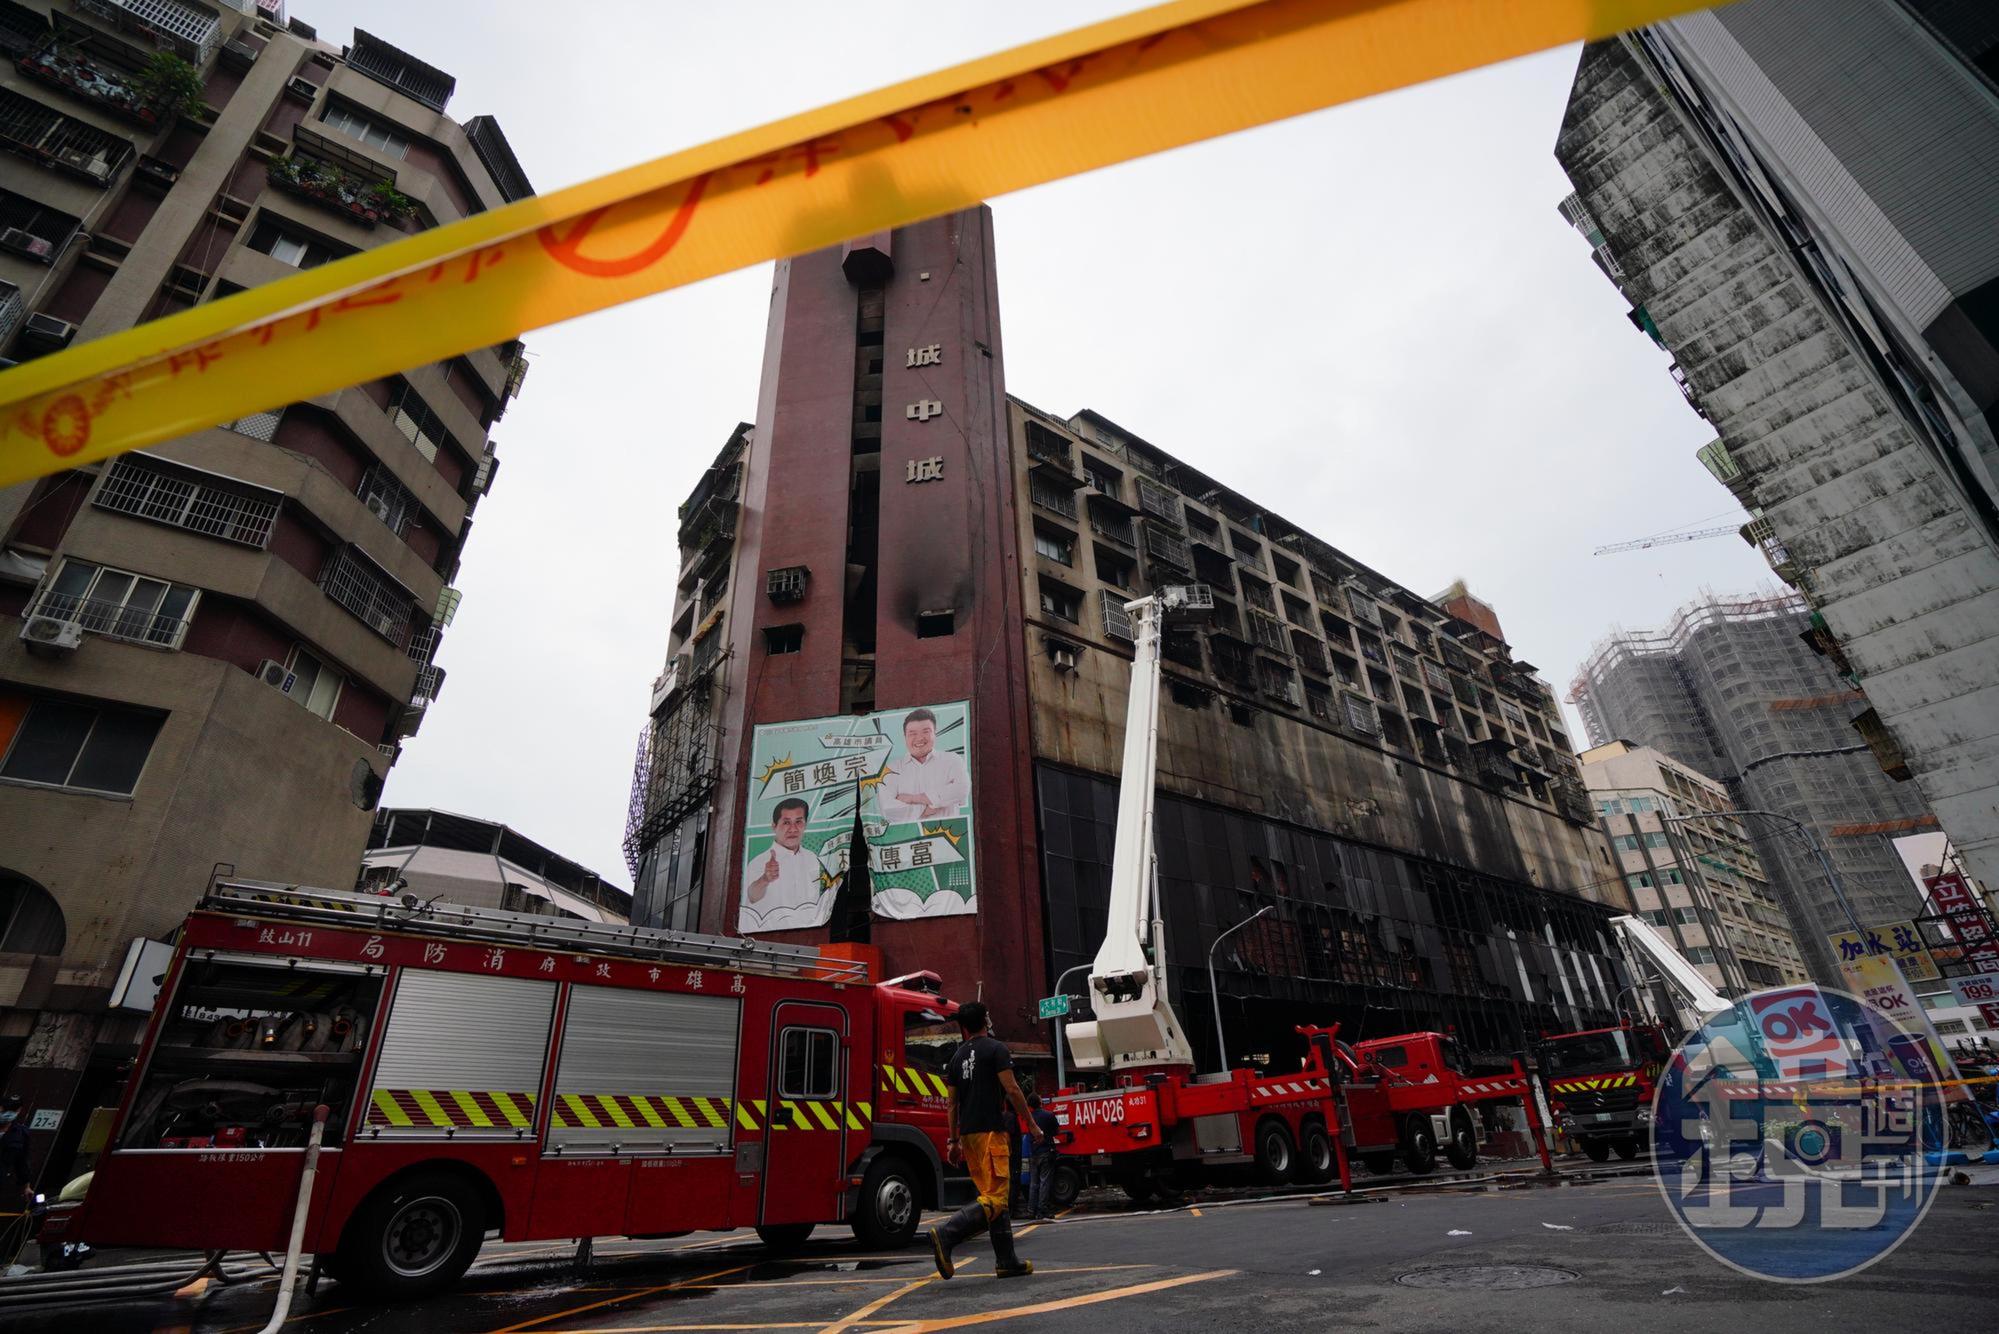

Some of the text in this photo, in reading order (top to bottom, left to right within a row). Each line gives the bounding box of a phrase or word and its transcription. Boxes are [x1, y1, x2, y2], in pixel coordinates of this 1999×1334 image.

[906, 343, 944, 482] 城中城
[784, 756, 868, 793] 簡煥宗
[259, 928, 313, 947] 鼓山11
[1839, 926, 1921, 961] 加水站
[1961, 984, 1993, 1000] 199
[1762, 1001, 1831, 1043] OK
[1075, 1099, 1125, 1125] AAV-026
